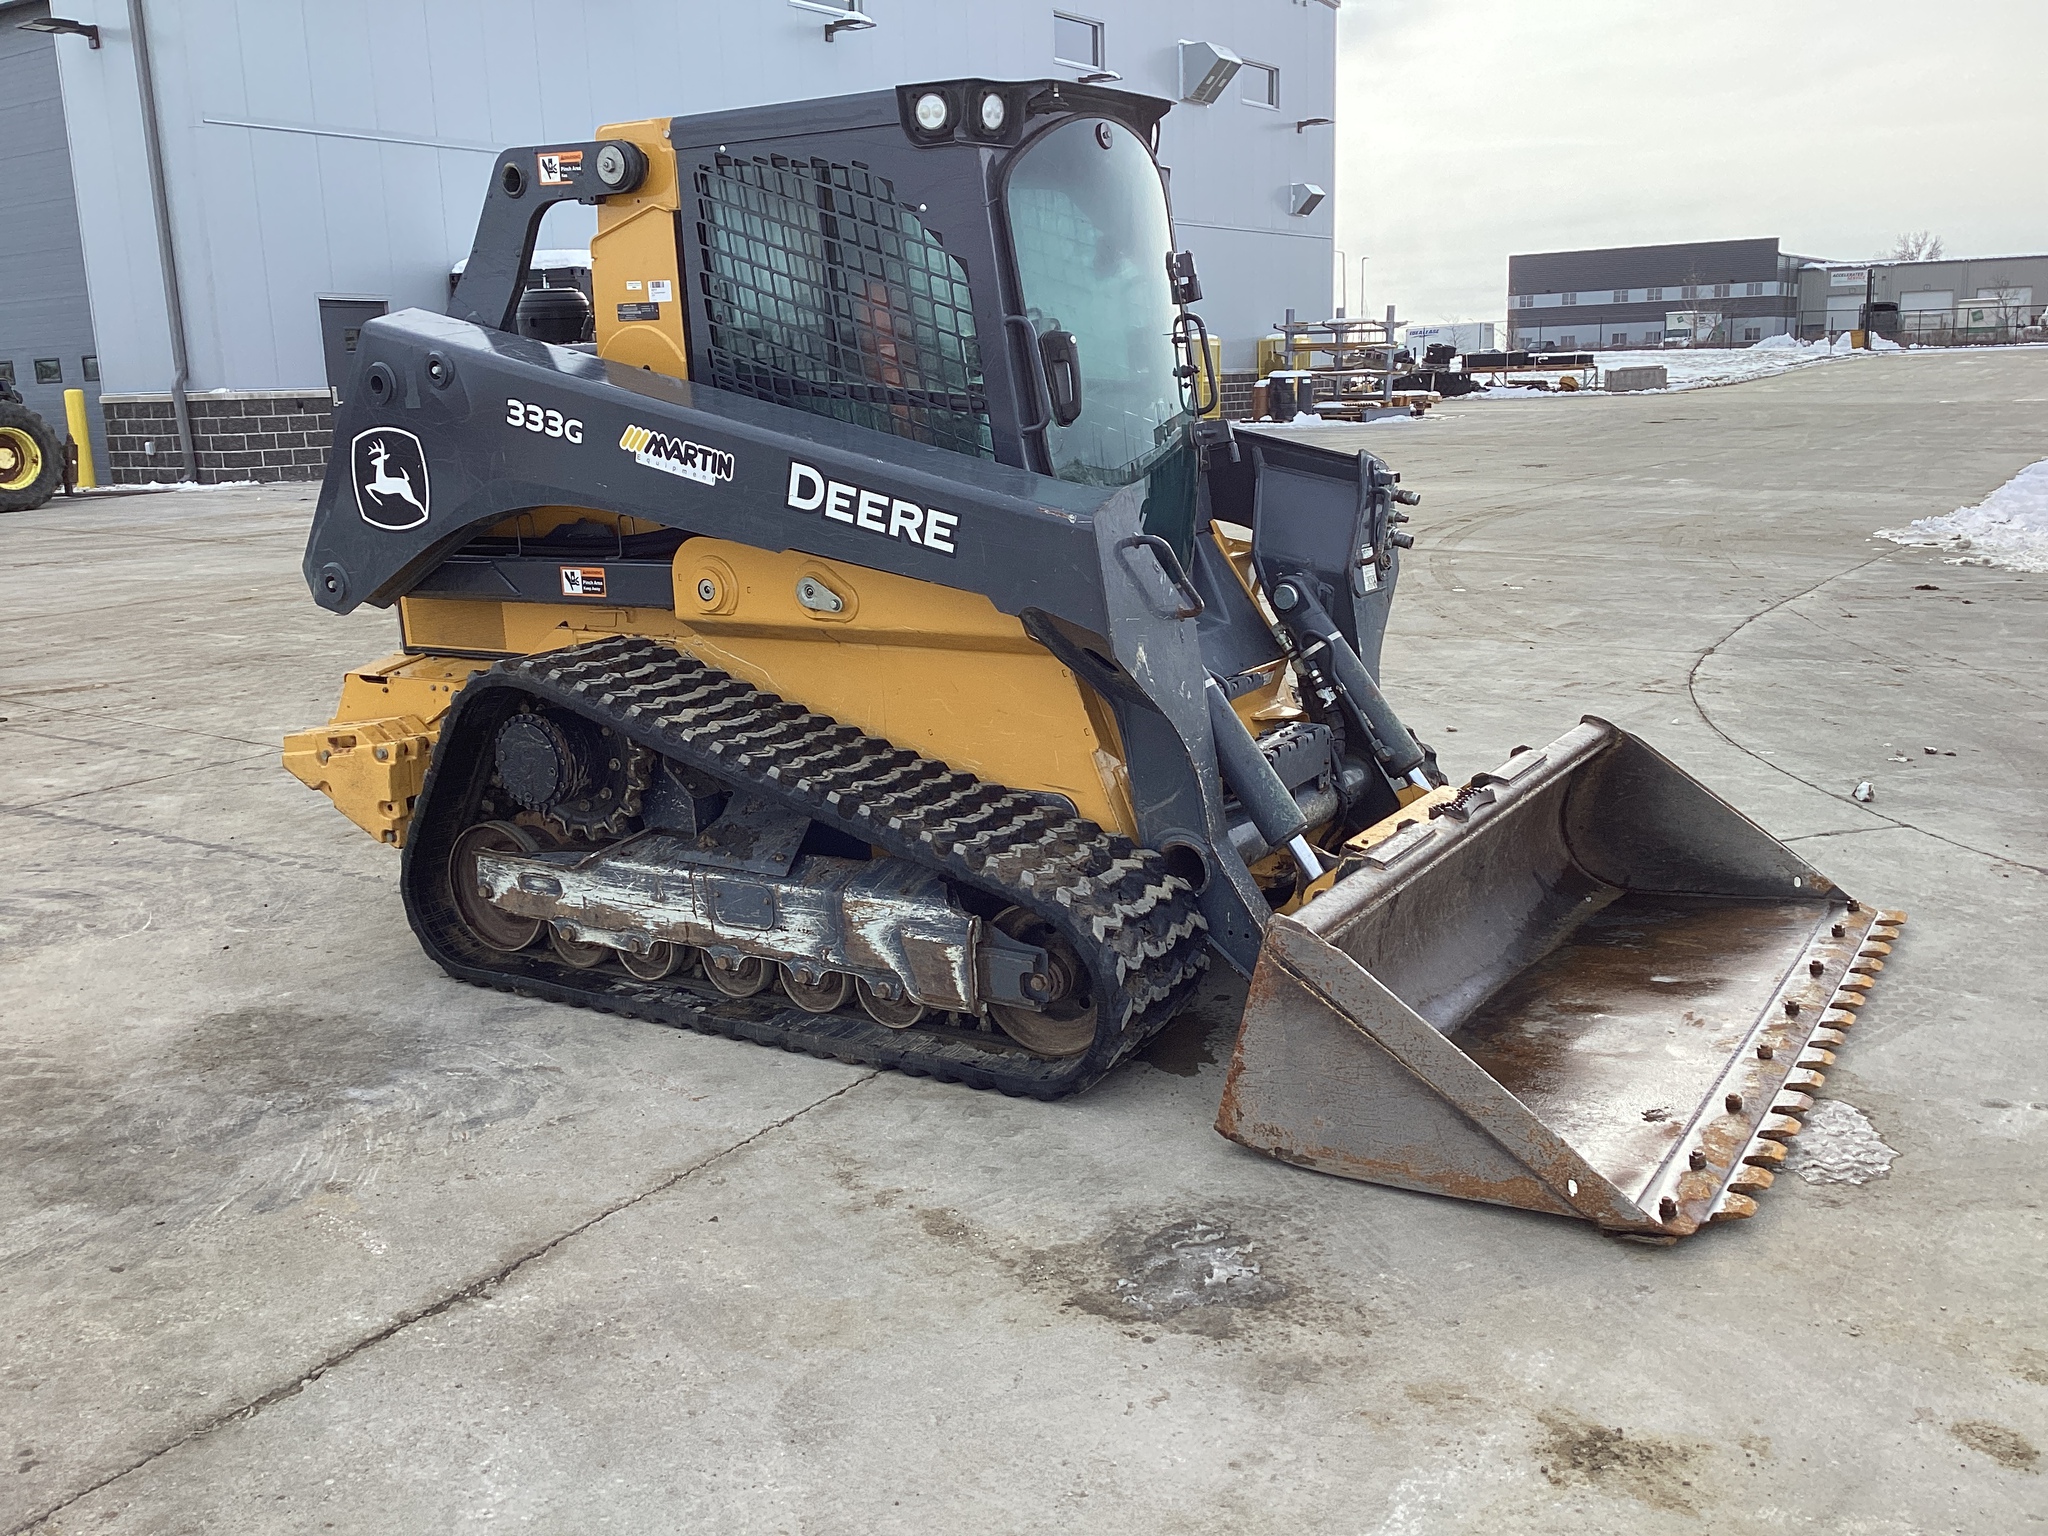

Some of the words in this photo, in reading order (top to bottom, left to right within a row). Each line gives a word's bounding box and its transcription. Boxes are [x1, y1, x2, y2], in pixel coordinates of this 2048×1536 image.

[505, 398, 584, 445] 333G
[636, 453, 716, 484] Equipment
[642, 432, 734, 481] MARTIN
[787, 461, 959, 554] DEERE
